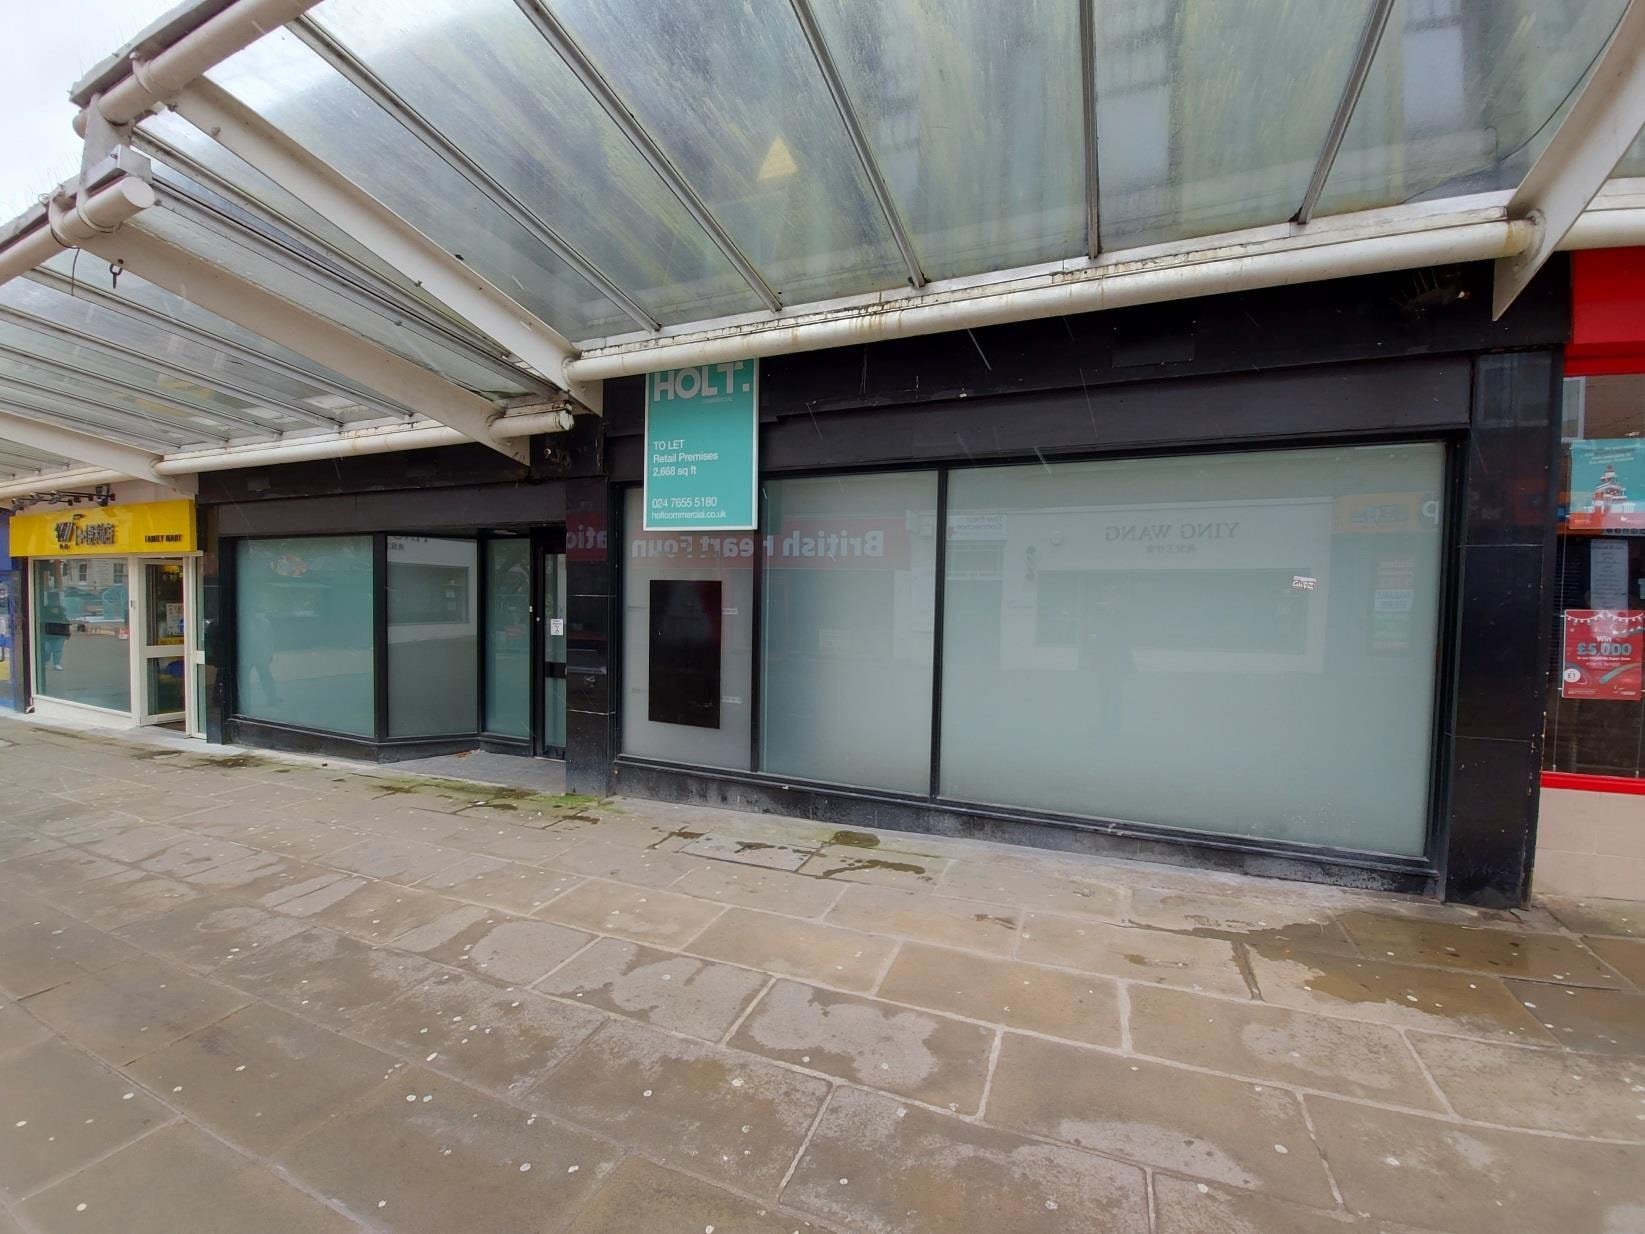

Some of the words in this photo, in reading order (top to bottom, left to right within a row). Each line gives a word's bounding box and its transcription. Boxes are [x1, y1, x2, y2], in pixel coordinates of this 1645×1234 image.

[654, 441, 666, 451] TO
[668, 439, 685, 450] LET
[653, 453, 677, 464] Retail
[678, 452, 719, 463] Premises
[653, 467, 676, 478] 2,668
[677, 468, 688, 478] sq
[690, 466, 697, 475] ft
[652, 497, 668, 509] 024
[671, 497, 692, 508] 7655
[694, 496, 718, 508] 5180
[651, 509, 727, 520] holtcommercial.co.uk
[1596, 635, 1612, 643] Win
